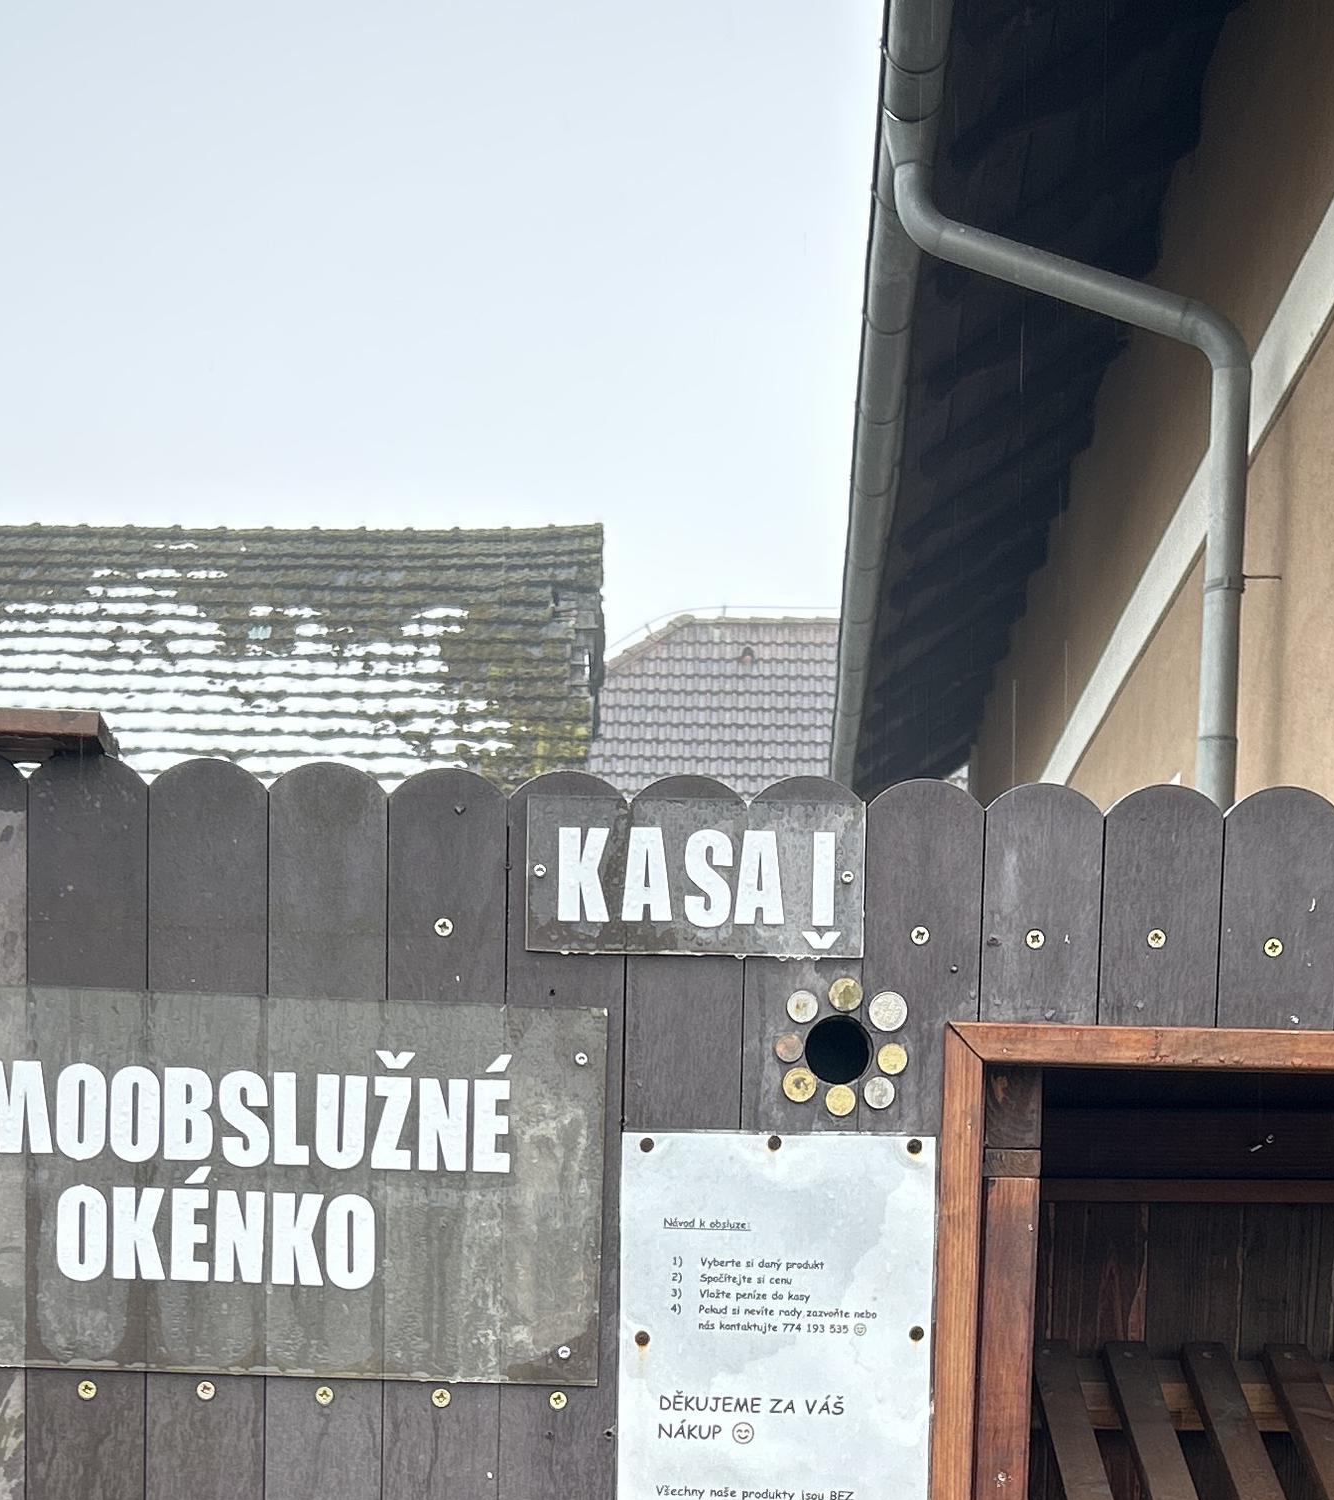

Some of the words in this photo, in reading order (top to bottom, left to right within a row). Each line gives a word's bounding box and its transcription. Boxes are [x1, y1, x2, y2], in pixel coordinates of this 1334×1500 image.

[558, 826, 785, 928] KASA
[55, 1165, 376, 1290] OKÉNKO
[663, 1217, 695, 1228] Návod
[699, 1218, 706, 1228] k
[672, 1256, 683, 1268] 1)
[700, 1257, 742, 1269] Vyberte
[745, 1259, 754, 1267] si
[758, 1258, 782, 1271] daný
[786, 1260, 825, 1271] produkt
[671, 1272, 683, 1284] 2)
[700, 1273, 753, 1286] Spočítejte
[757, 1275, 765, 1284] si
[769, 1277, 793, 1285] cenu
[671, 1288, 682, 1300] 3)
[700, 1289, 732, 1299] Vložte
[736, 1290, 767, 1302] peníze
[771, 1291, 784, 1300] do
[788, 1290, 811, 1304] kasy
[670, 1303, 682, 1315] 4)
[699, 1304, 728, 1315] Pokud
[732, 1305, 740, 1315] si
[744, 1306, 775, 1316] nevíte
[806, 1308, 850, 1319] zazvoňte
[854, 1310, 878, 1320] nebo
[698, 1320, 715, 1330] nás
[719, 1321, 778, 1334] kontaktujte
[782, 1322, 802, 1332] 774
[806, 1323, 825, 1333] 193
[829, 1324, 849, 1334] 535
[659, 1390, 762, 1413] DĚKUJEME
[769, 1398, 796, 1414] ZA
[805, 1395, 845, 1416] VÁŠ
[657, 1419, 723, 1440] NÁKUP
[656, 1485, 705, 1500] Všechny
[710, 1487, 737, 1498] naše
